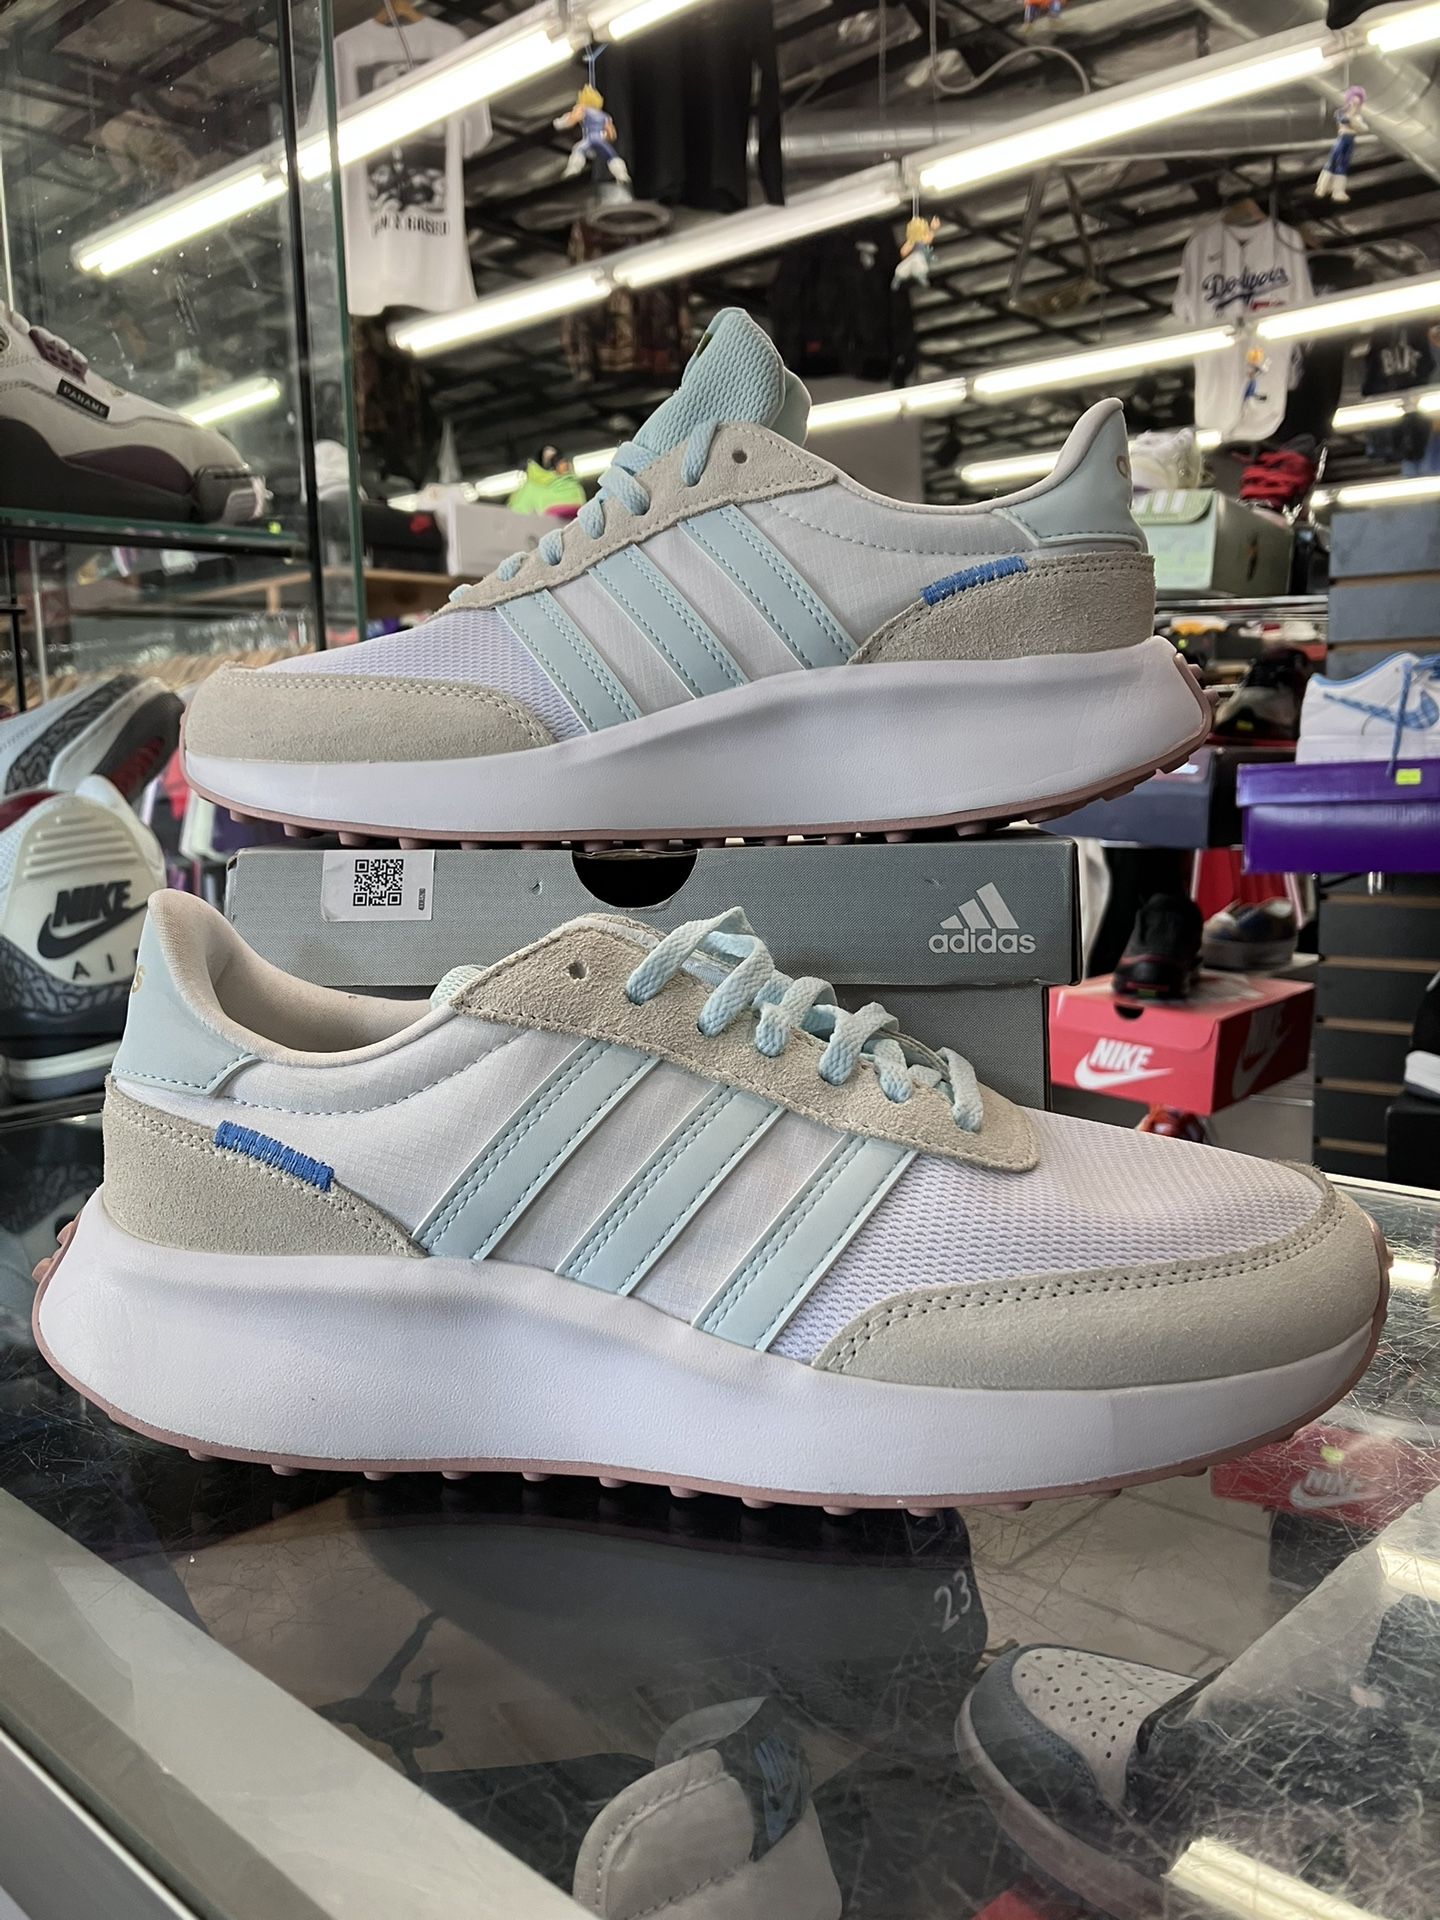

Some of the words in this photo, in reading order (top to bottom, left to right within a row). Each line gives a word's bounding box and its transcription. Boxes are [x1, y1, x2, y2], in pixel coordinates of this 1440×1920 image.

[1202, 265, 1289, 302] Dodgers
[53, 879, 131, 929] NIKE
[928, 928, 1037, 954] adidas
[72, 947, 139, 981] AI
[1089, 1036, 1154, 1073] NIKE
[1303, 1466, 1362, 1497] NIKE
[934, 1569, 971, 1633] 23
